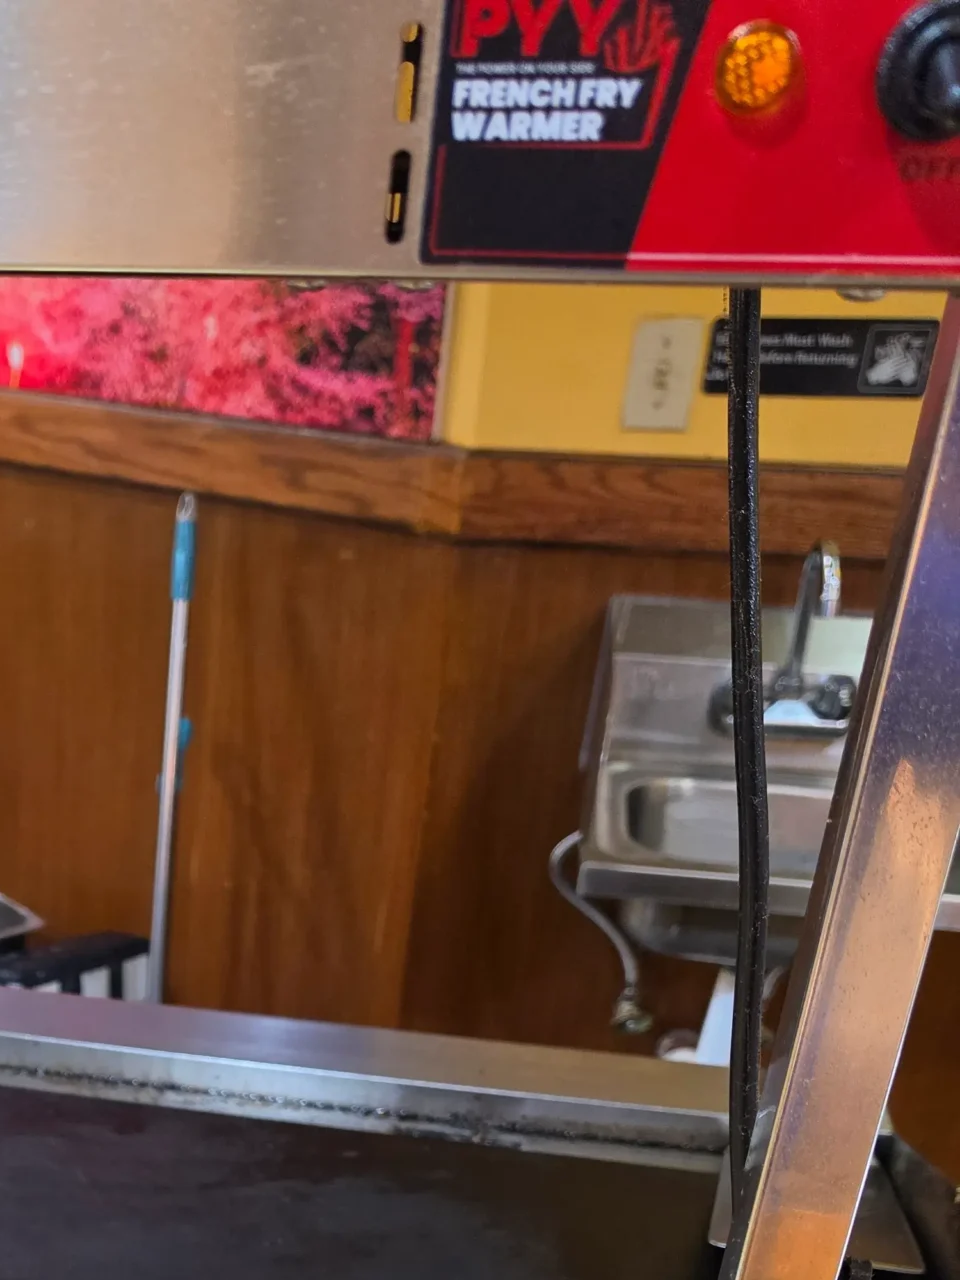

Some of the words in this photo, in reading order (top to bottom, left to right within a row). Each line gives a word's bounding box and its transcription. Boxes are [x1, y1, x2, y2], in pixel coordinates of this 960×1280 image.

[461, 0, 622, 57] PYY
[452, 79, 576, 108] FRENCH
[579, 79, 642, 108] FRY
[451, 111, 605, 141] WARMER
